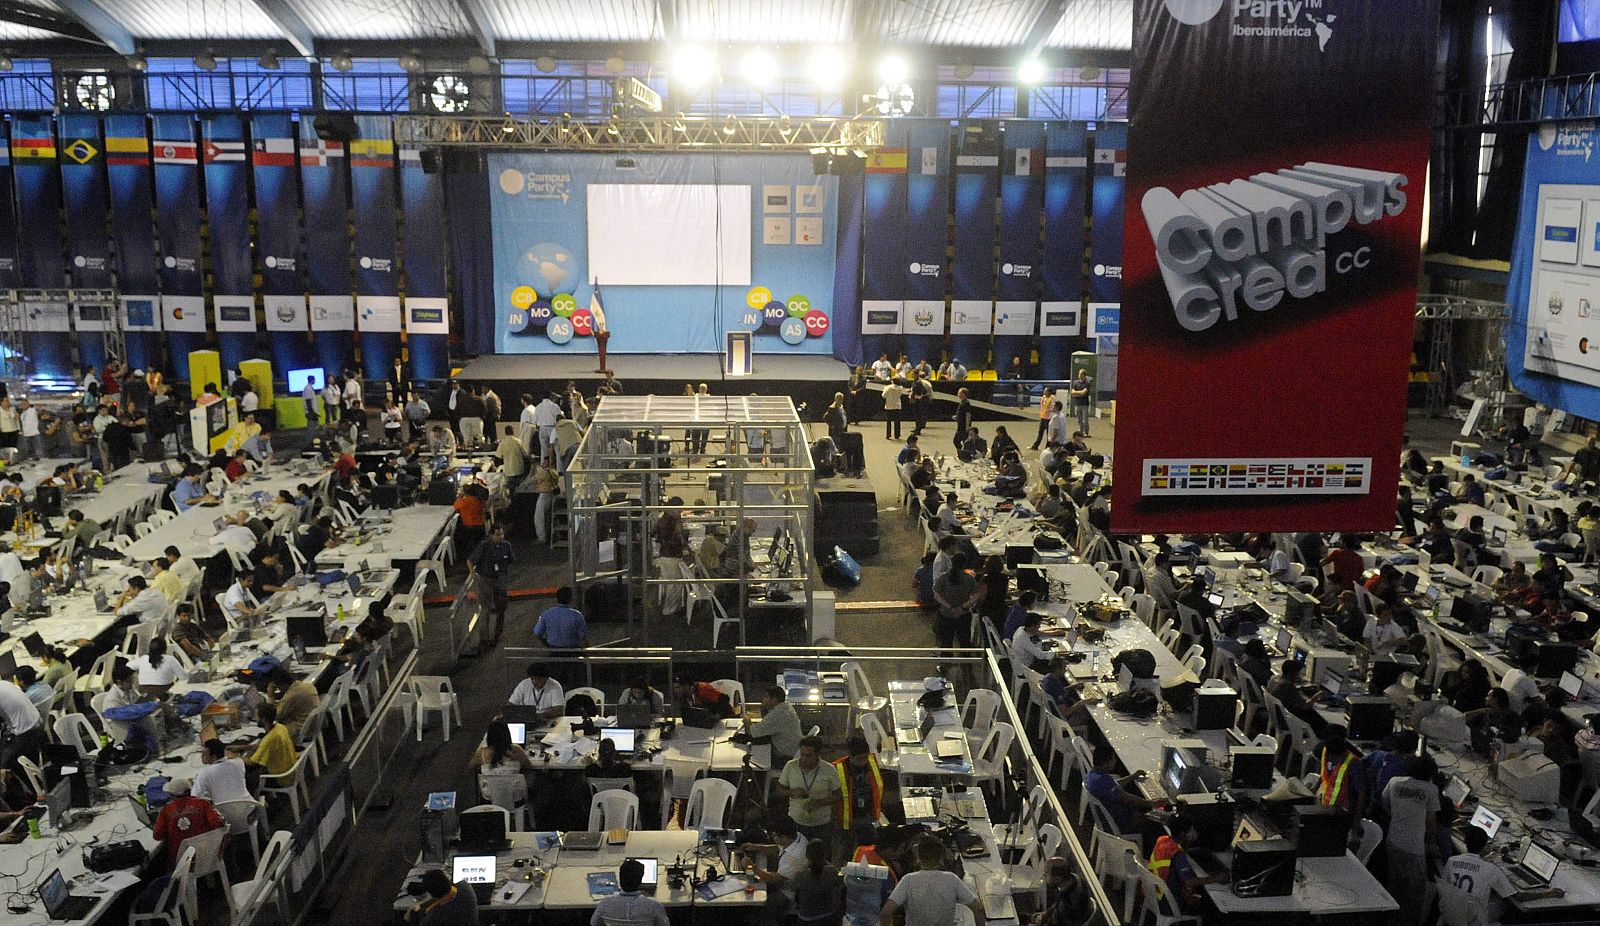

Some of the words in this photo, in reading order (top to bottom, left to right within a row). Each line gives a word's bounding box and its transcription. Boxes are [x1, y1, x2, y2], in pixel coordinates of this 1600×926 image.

[1233, 24, 1312, 37] Iberoamérica
[527, 172, 571, 183] Campus
[553, 300, 575, 311] OC
[788, 301, 809, 311] OC
[530, 307, 551, 318] MO
[765, 308, 785, 318] MO
[509, 313, 523, 325] IN
[743, 313, 757, 325] IN
[806, 316, 828, 328] CC
[551, 323, 570, 336] AS
[784, 324, 802, 337] AS
